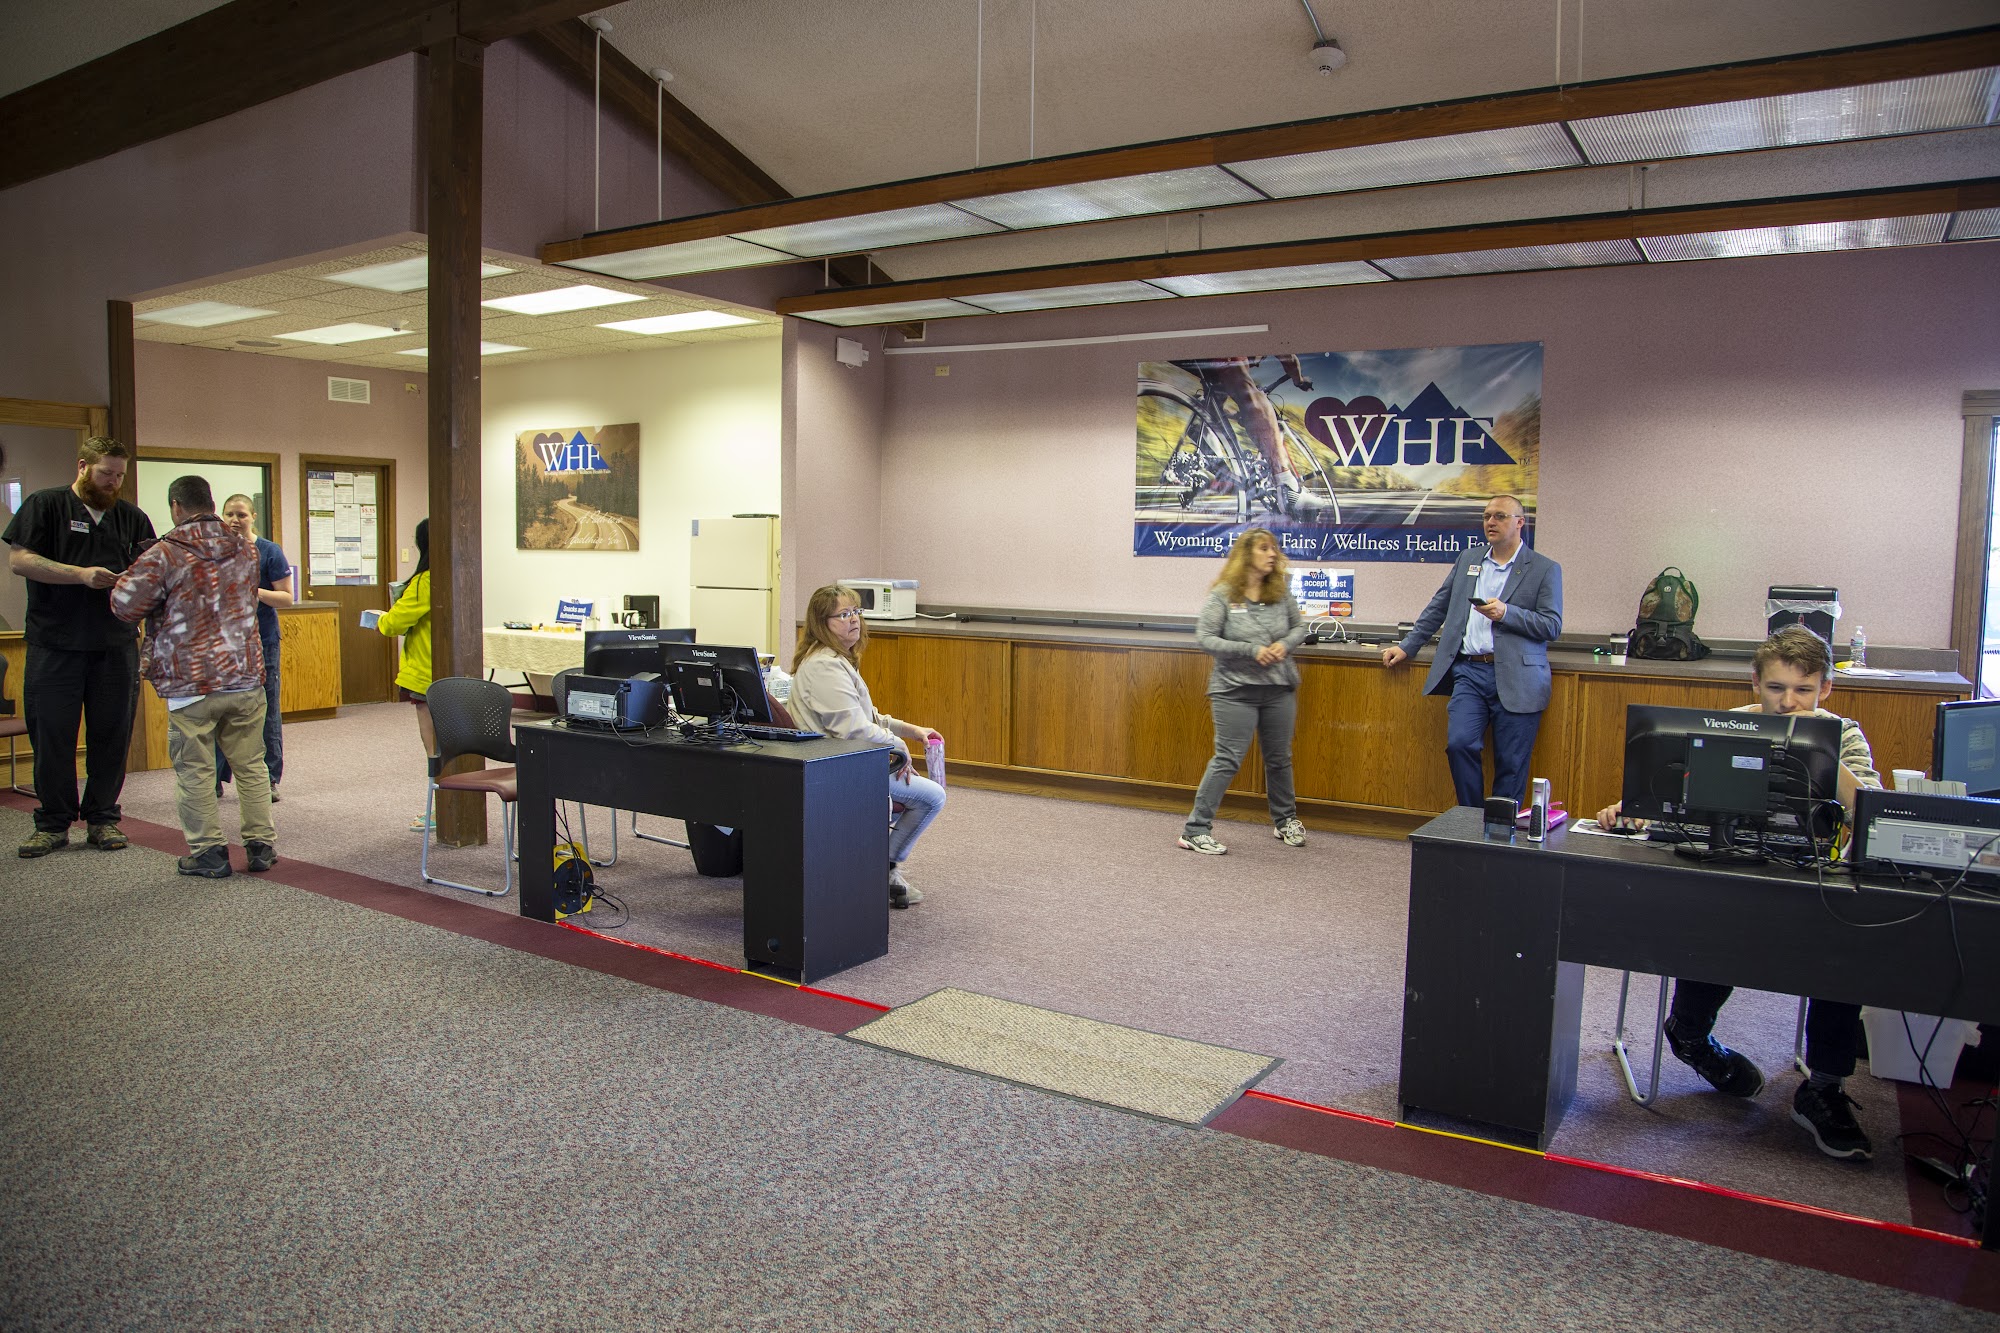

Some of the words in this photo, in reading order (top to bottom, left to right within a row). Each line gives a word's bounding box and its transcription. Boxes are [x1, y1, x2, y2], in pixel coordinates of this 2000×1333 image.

[1319, 414, 1493, 466] WHF
[539, 442, 600, 471] WHF
[1154, 530, 1224, 552] Wyoming
[1281, 532, 1317, 549] Fairs
[1333, 533, 1400, 551] Wellness
[1406, 534, 1460, 552] Health
[1304, 580, 1327, 588] accept
[692, 650, 717, 658] ViewSonic
[1704, 718, 1759, 731] ViewSonic
